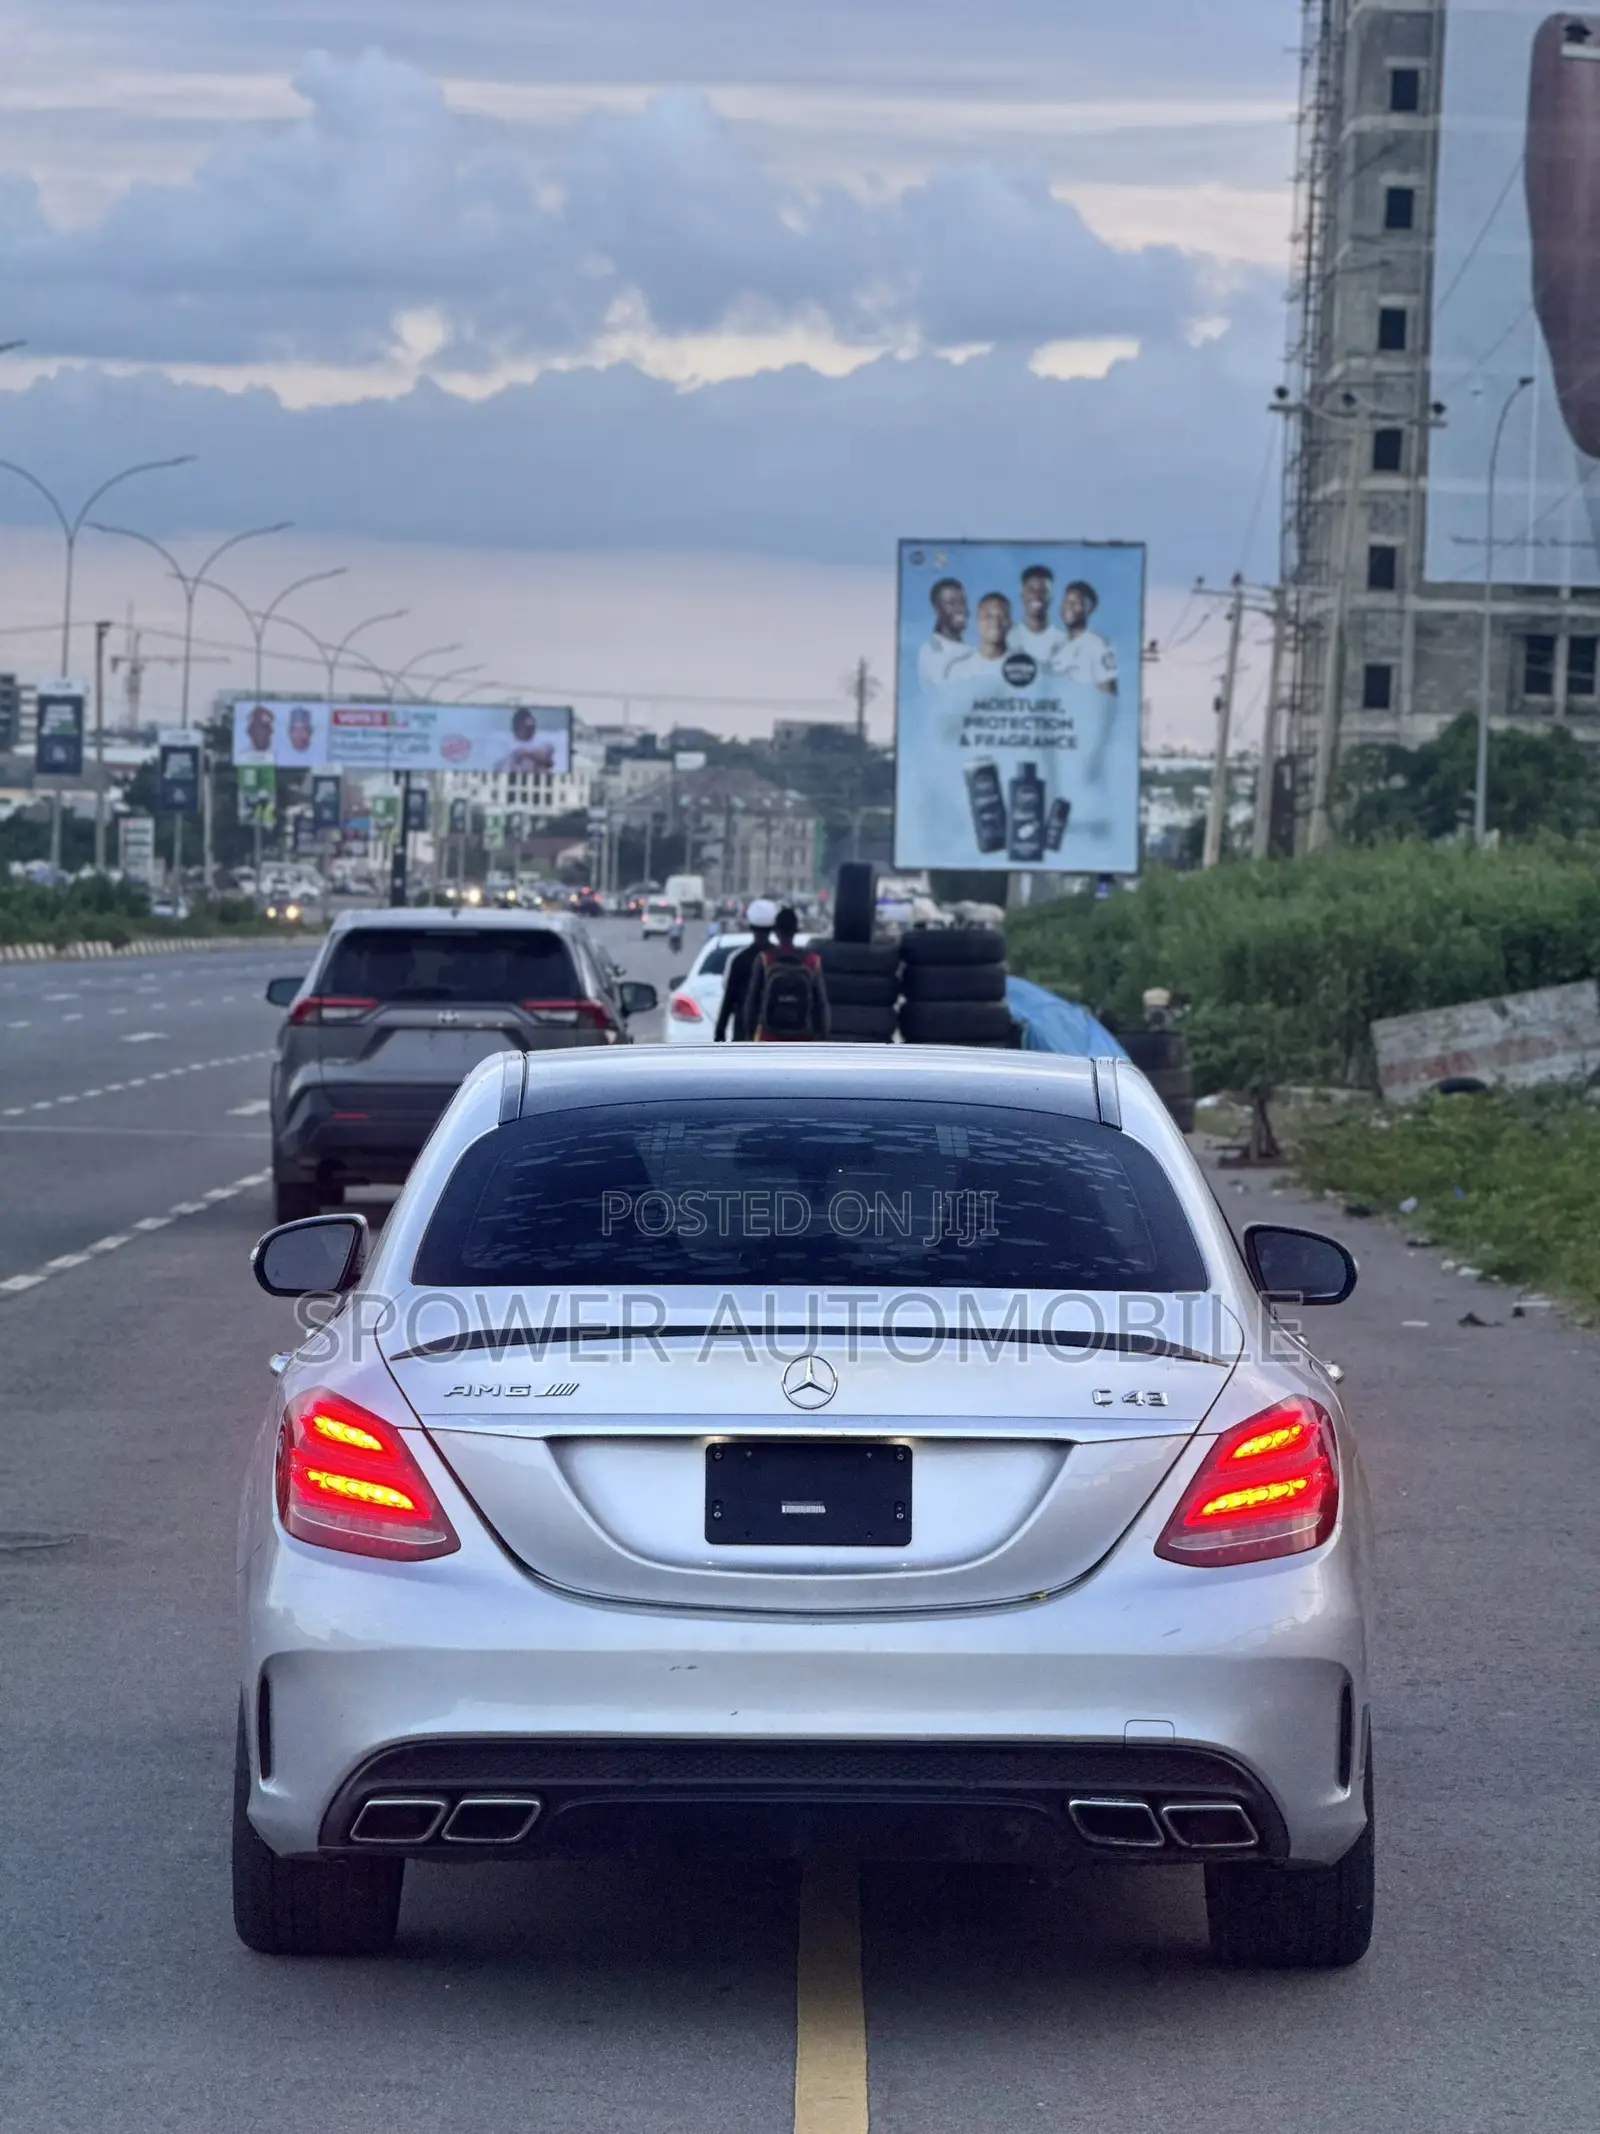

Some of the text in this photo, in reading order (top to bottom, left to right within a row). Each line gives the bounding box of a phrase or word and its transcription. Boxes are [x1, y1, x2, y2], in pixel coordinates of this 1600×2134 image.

[963, 716, 1074, 731] PROTECTION
[974, 733, 1078, 750] FRAGRANCE
[444, 1383, 532, 1397] AMG
[1092, 1388, 1168, 1407] C 43
